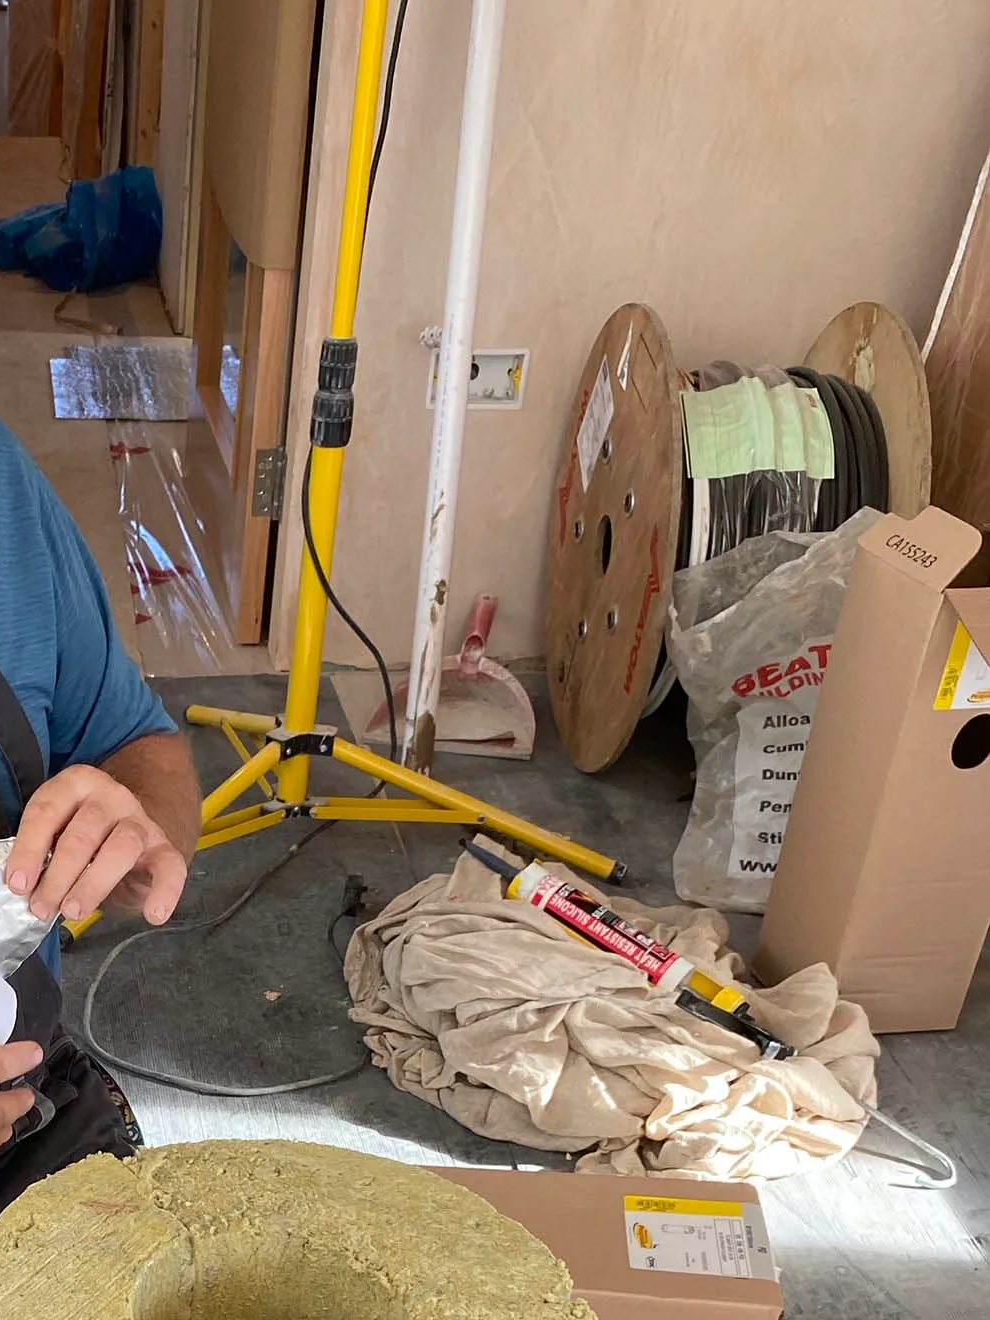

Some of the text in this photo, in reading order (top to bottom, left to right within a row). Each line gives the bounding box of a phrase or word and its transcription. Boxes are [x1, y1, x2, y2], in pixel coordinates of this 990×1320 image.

[762, 714, 811, 729] Alloa
[762, 741, 809, 754] Cum
[761, 768, 801, 781] Dun
[550, 894, 590, 925] SILICONE
[587, 919, 640, 957] RESISTANT
[634, 951, 661, 972] HEAT
